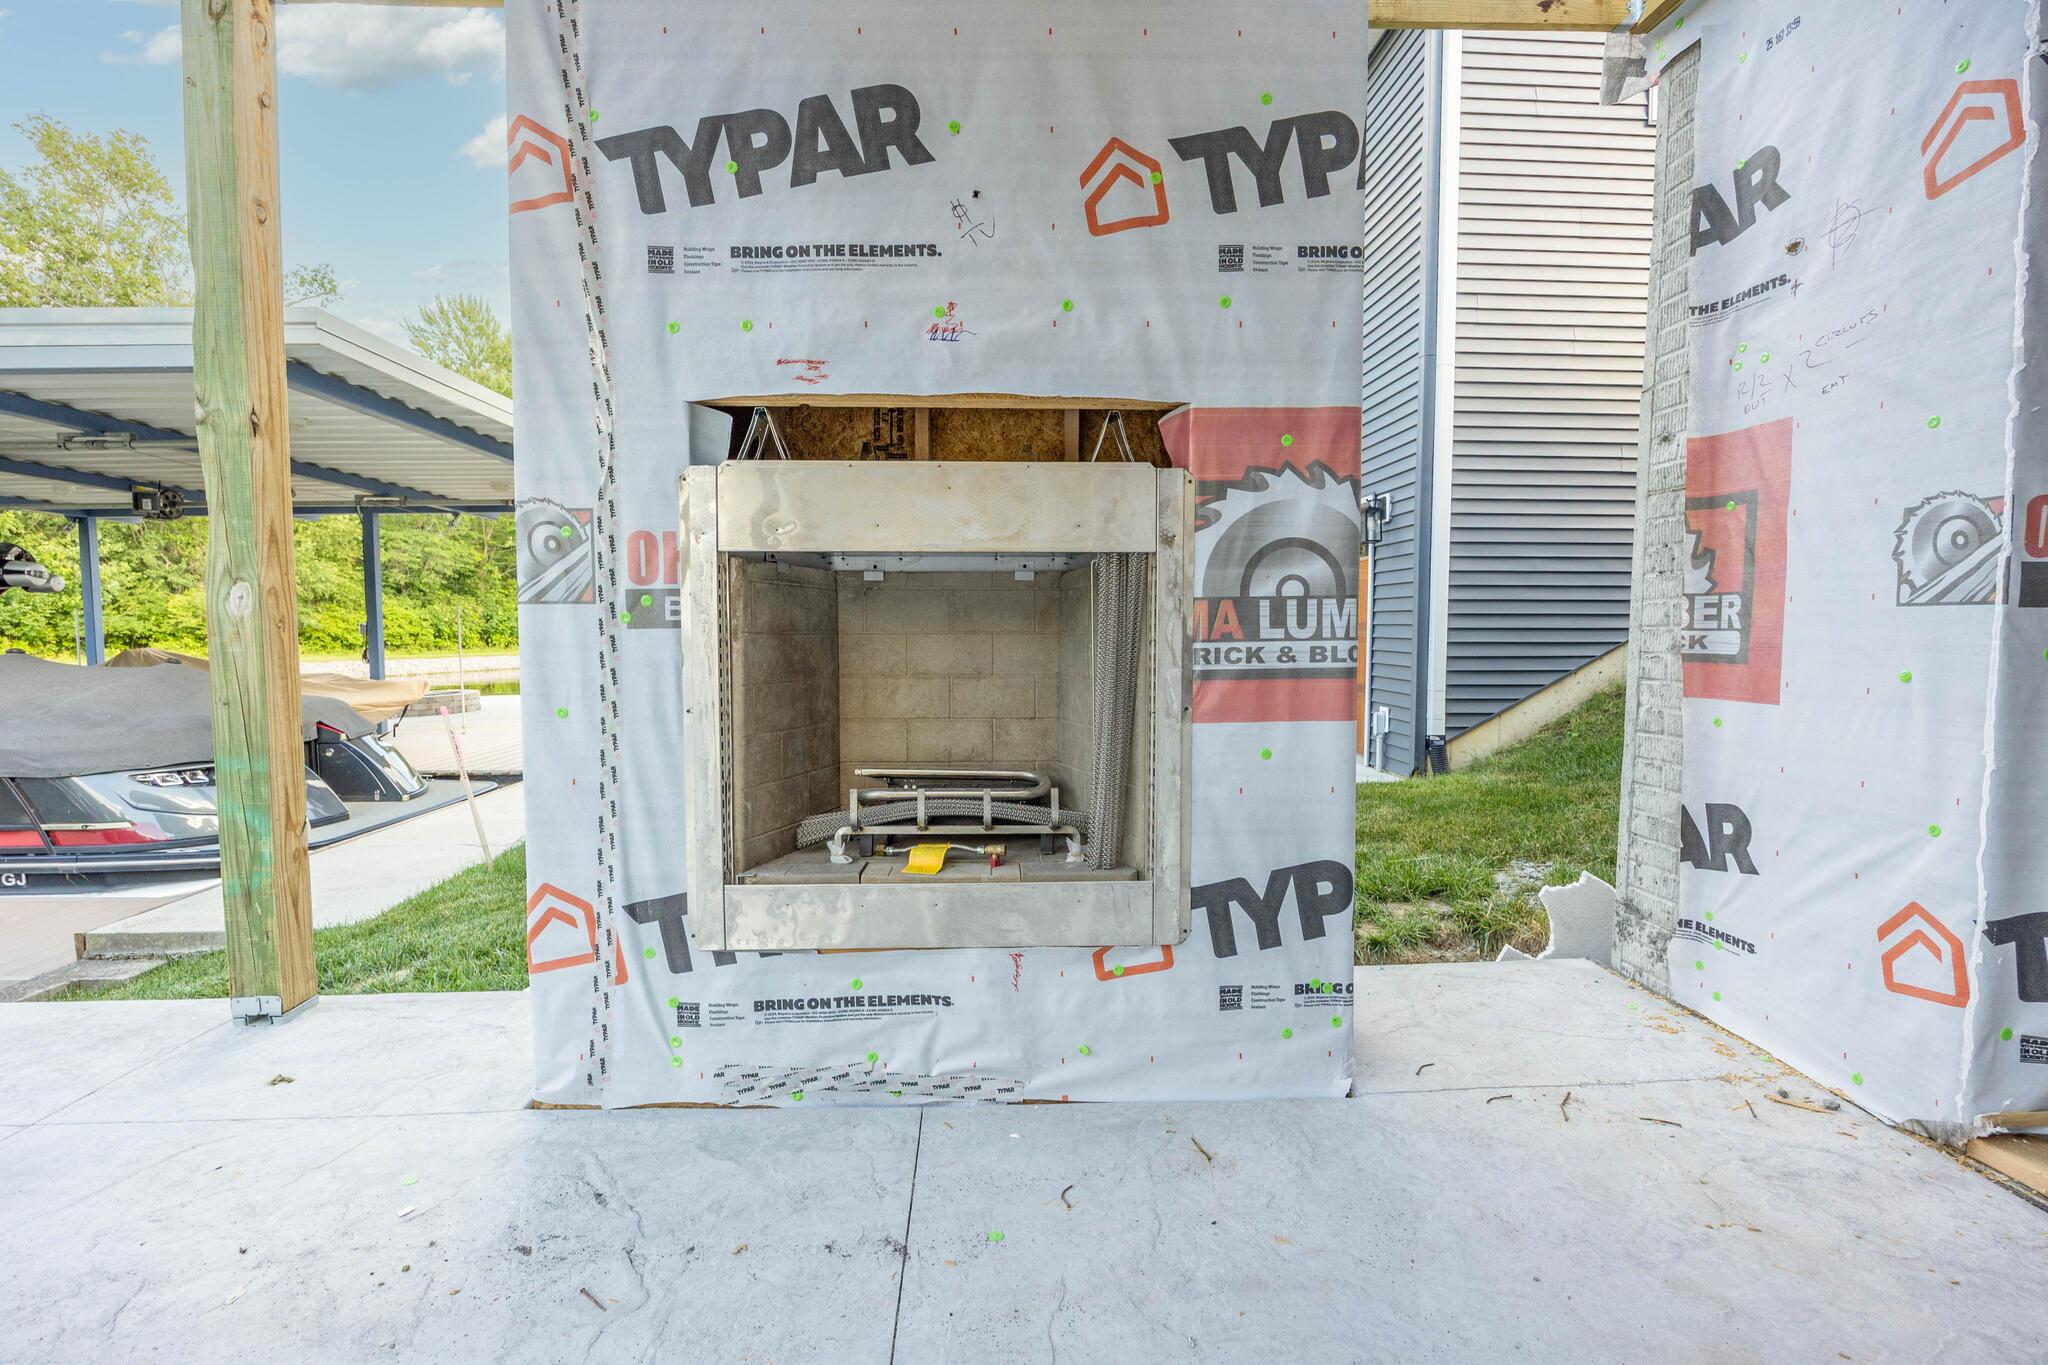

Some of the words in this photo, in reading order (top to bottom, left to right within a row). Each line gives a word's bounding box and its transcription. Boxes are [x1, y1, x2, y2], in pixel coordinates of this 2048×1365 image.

[594, 84, 936, 215] TYPAR
[1167, 111, 1365, 215] TYP
[1690, 145, 1791, 257] AR
[730, 246, 783, 259] BRING
[785, 245, 811, 258] ON
[813, 244, 846, 257] THE
[848, 243, 942, 258] ELEMENTS.
[1297, 245, 1348, 259] BRING
[1350, 245, 1364, 259] O
[1689, 302, 1719, 316] THE
[1721, 274, 1791, 310] ELEMENTS.
[1259, 598, 1358, 640] LUM
[1193, 646, 1266, 665] RICK
[1276, 645, 1297, 664] &
[1695, 921, 1757, 955] ELEMENTS.
[753, 999, 805, 1012] BRING
[807, 998, 832, 1010] ON
[833, 996, 866, 1008] THE
[867, 994, 955, 1007] ELEMENTS.
[737, 1085, 756, 1096] TYPAR
[768, 1081, 787, 1091] TYPAR
[801, 1076, 818, 1086] TYPAR
[832, 1072, 850, 1082] TYPAR
[741, 1072, 759, 1081] TYPAR
[963, 1085, 982, 1093] TYPAR
[996, 1086, 1015, 1094] TYPAR
